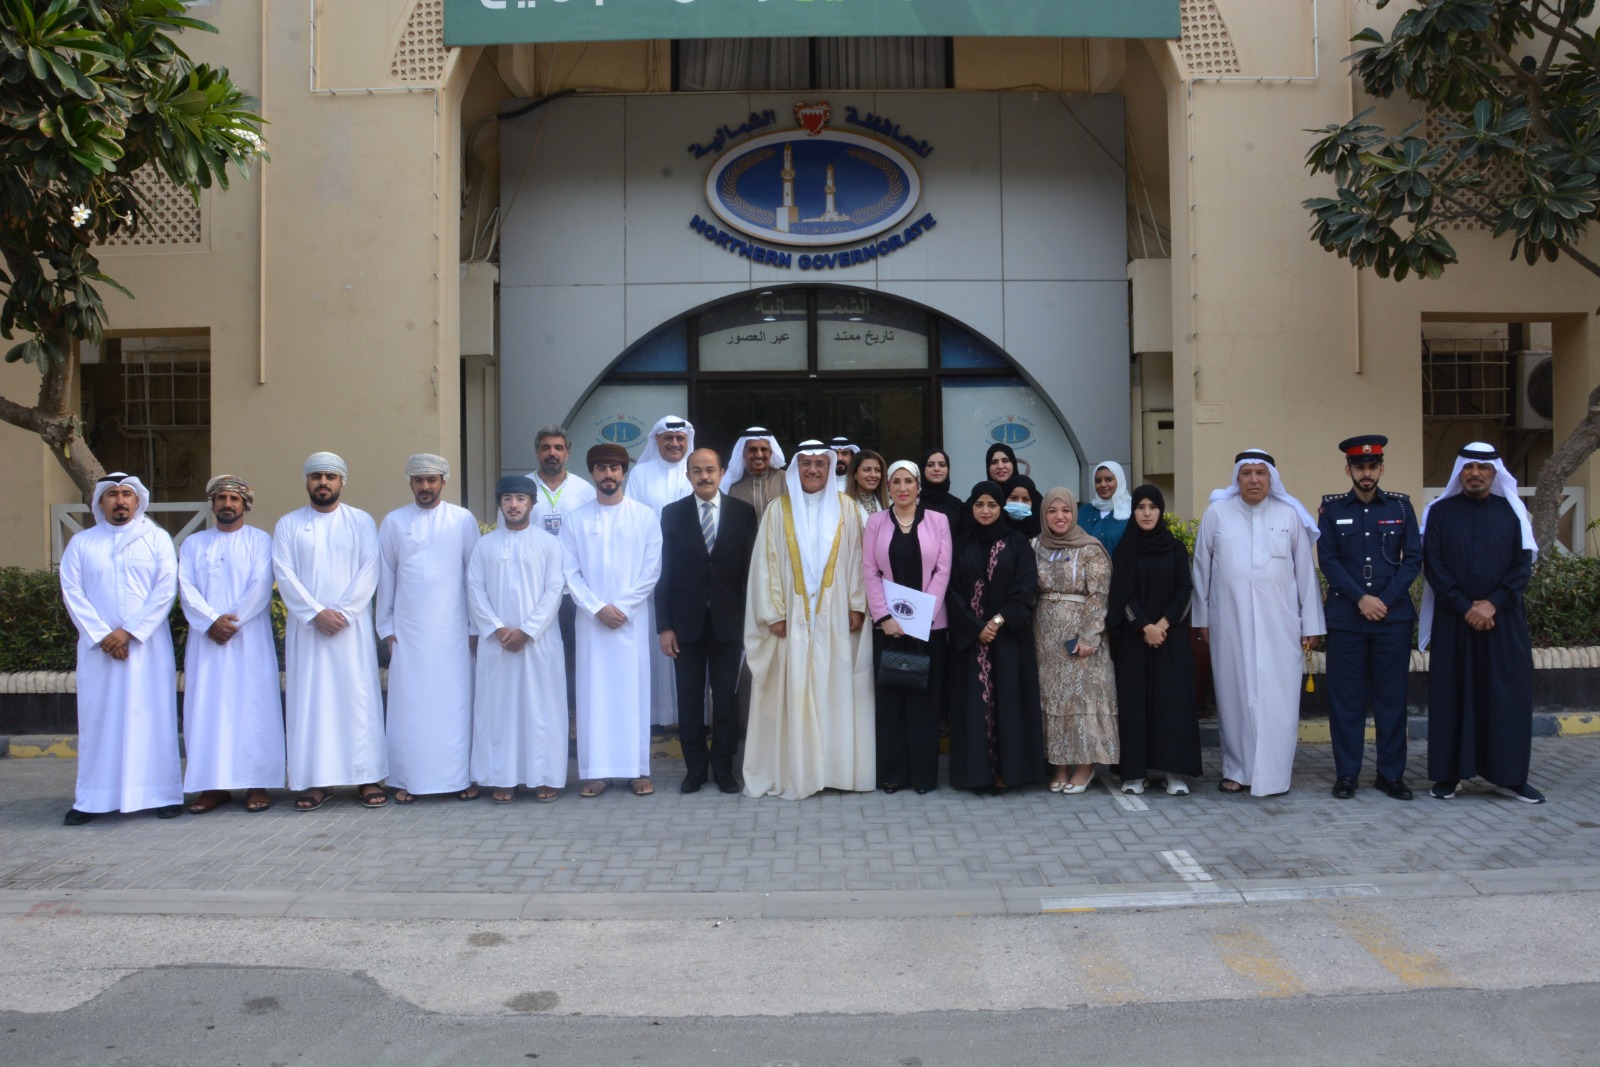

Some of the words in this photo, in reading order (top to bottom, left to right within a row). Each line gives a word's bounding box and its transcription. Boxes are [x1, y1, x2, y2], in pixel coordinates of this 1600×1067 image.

[687, 108, 777, 159] الشمالية
[845, 105, 934, 158] المحافظة
[689, 214, 792, 268] NORTHERN
[798, 212, 937, 270] GOVERNORATE
[726, 330, 766, 345] العصور
[770, 331, 790, 344] عبر
[834, 331, 861, 341] ممتد
[864, 330, 894, 346] تاريخ
